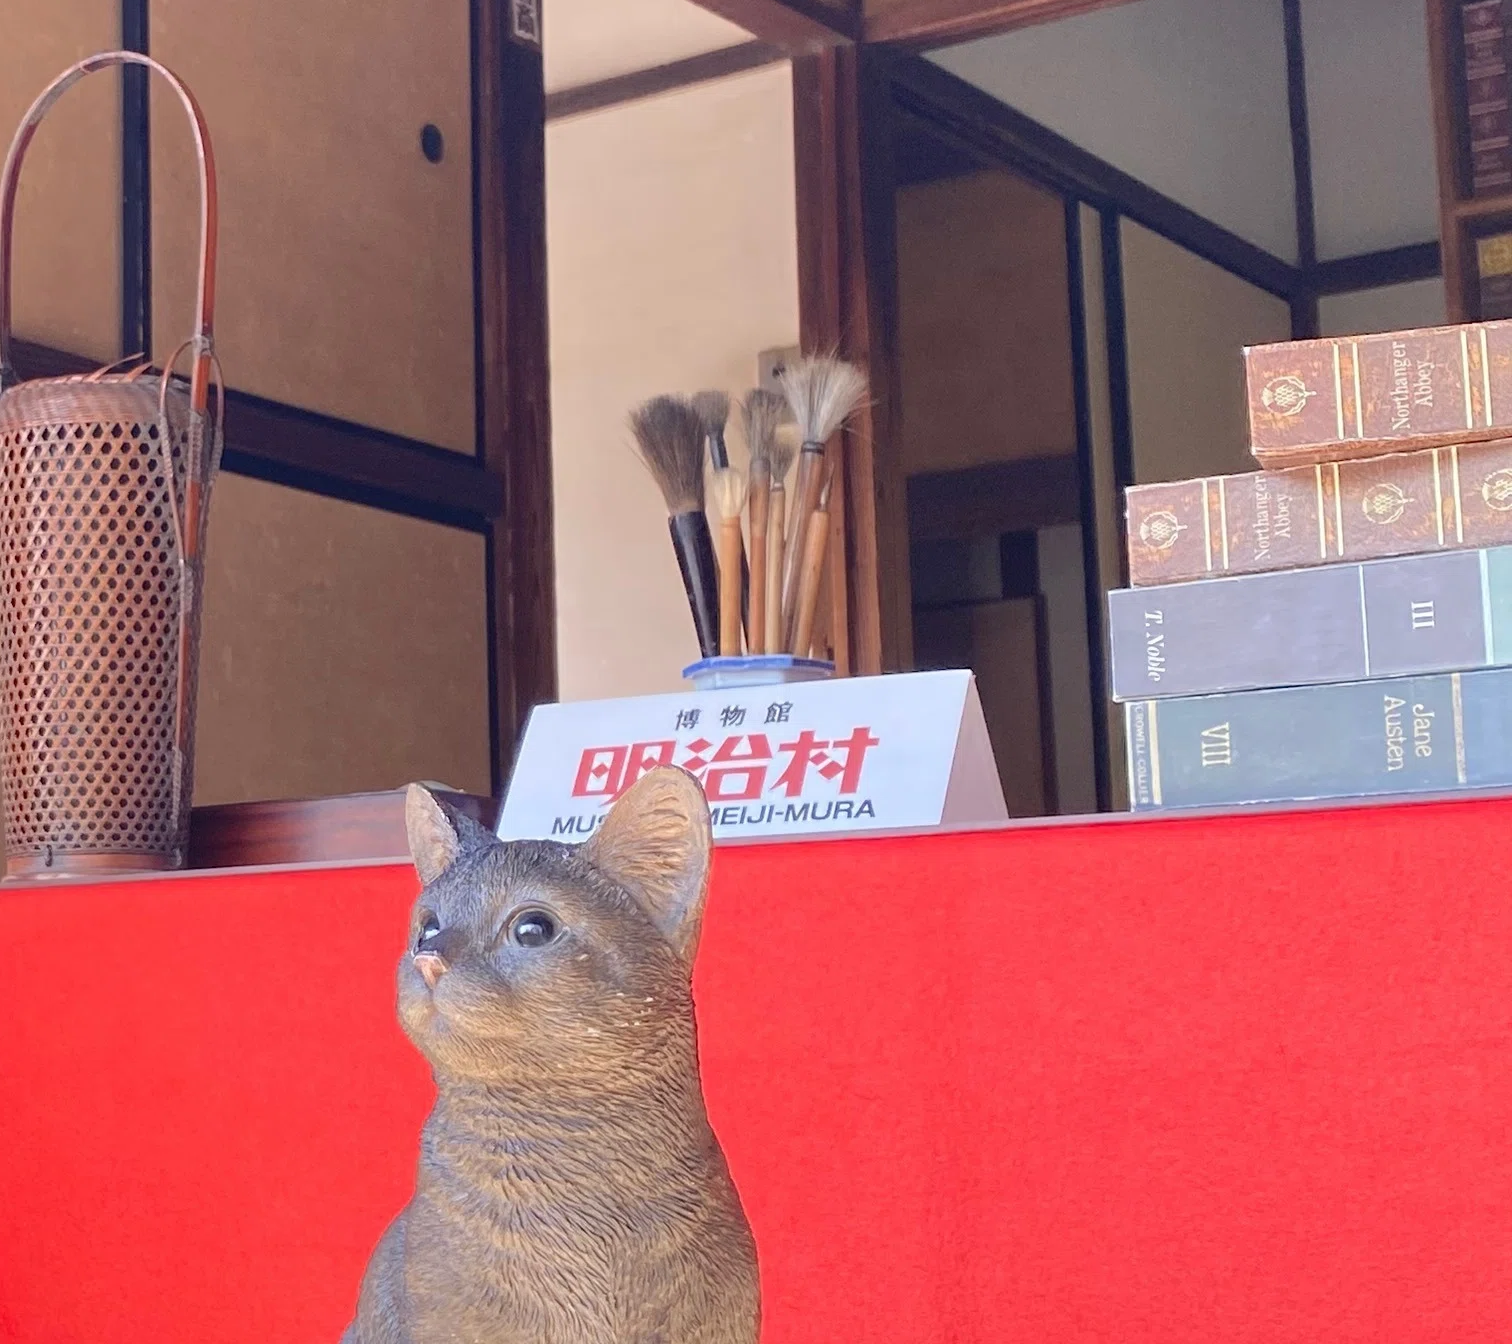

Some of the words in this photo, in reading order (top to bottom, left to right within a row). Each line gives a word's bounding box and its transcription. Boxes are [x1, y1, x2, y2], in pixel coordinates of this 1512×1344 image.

[1390, 341, 1412, 431] Northanger
[1413, 360, 1435, 408] Abbey
[1253, 475, 1272, 561] Northanger
[1273, 494, 1293, 538] Abbey
[1144, 610, 1163, 627] T.
[1411, 600, 1435, 629] III
[1145, 632, 1166, 682] Noble
[675, 701, 793, 731] 博物館
[1383, 694, 1407, 771] Austen
[1412, 703, 1435, 757] Jane
[571, 727, 880, 806] 明治村
[1201, 722, 1231, 767] VIII
